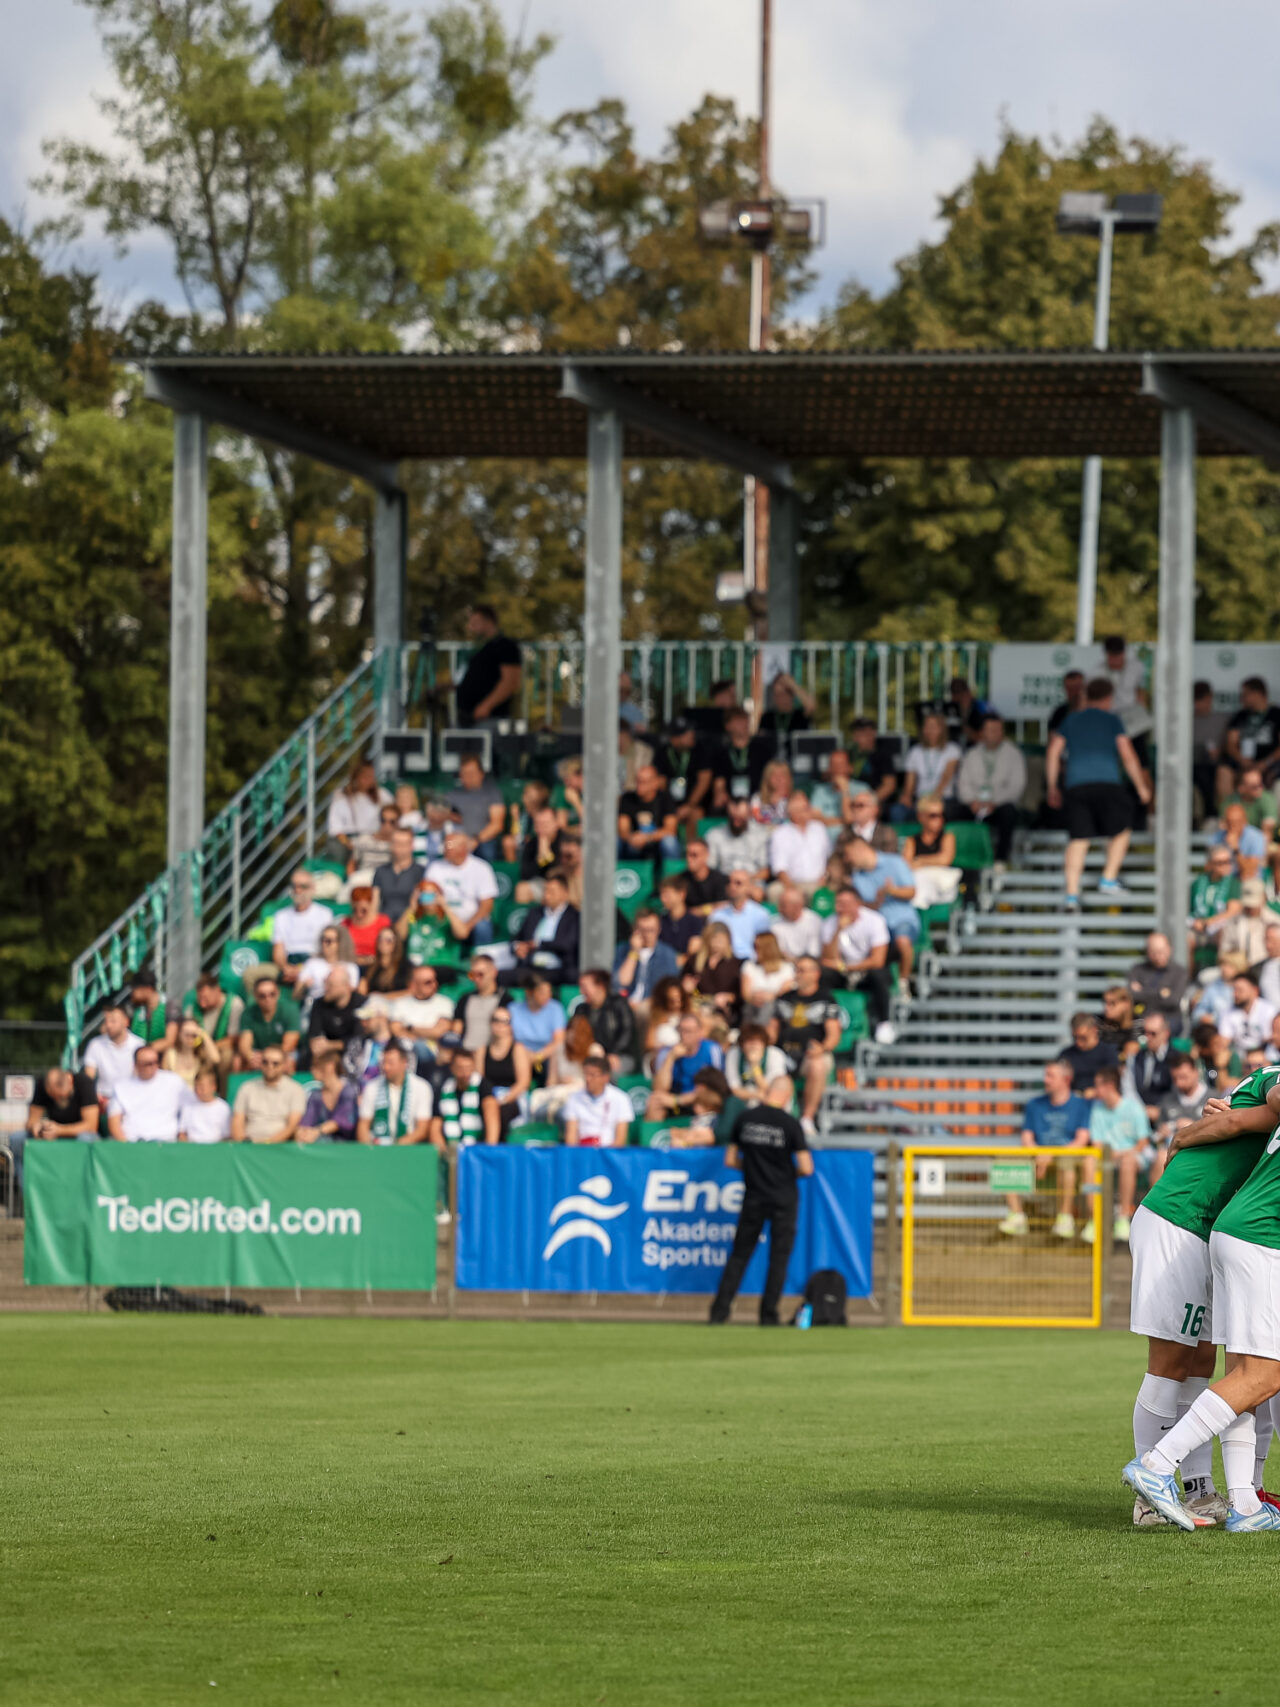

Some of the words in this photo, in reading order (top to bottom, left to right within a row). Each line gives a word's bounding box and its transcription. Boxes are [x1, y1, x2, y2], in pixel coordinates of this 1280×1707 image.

[642, 1170, 745, 1212] Ene
[97, 1195, 361, 1235] TedGifted.com
[642, 1242, 728, 1270] Sportu
[1181, 1302, 1206, 1337] 16
